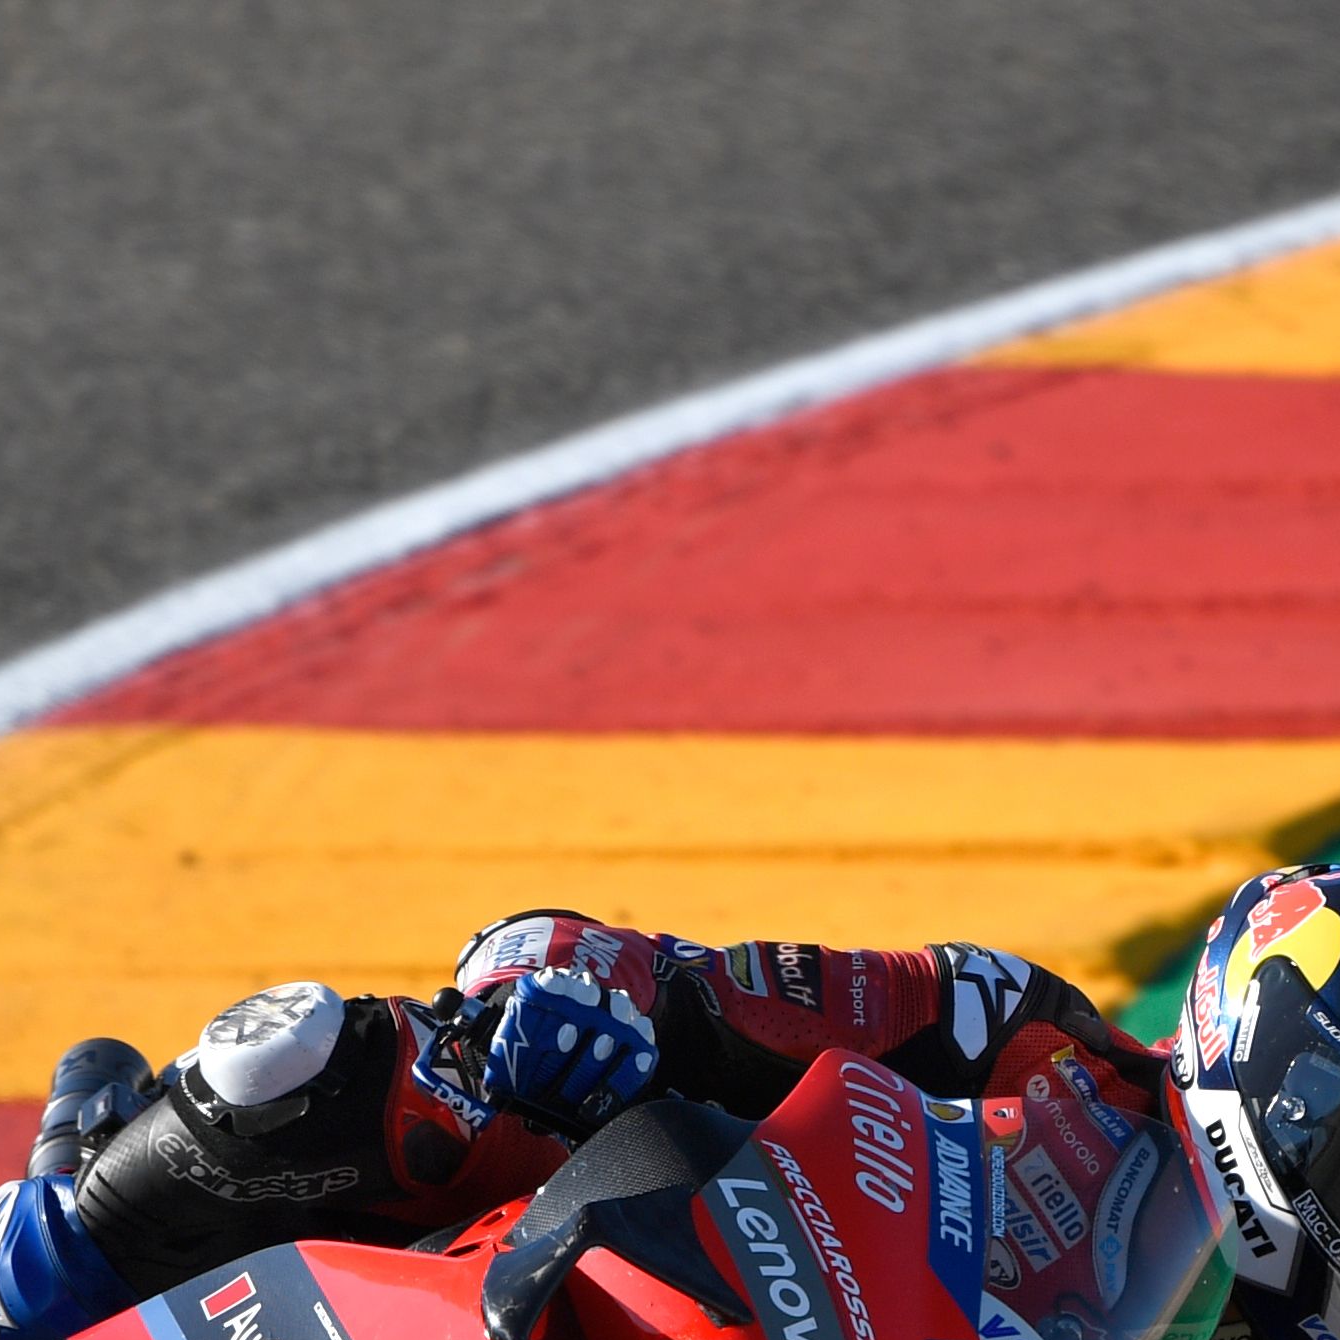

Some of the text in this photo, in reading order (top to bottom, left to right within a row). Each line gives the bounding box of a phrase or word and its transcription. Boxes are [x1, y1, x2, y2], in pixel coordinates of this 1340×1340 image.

[852, 975, 867, 1026] Sport
[843, 1066, 911, 1214] riello
[1045, 1101, 1101, 1176] motorola
[1074, 1077, 1127, 1139] MICHELIN
[156, 1133, 359, 1202] alpinestars
[934, 1130, 972, 1254] ADVANCE
[1106, 1147, 1151, 1234] BANCOMAT
[1205, 1119, 1278, 1259] DUCATI
[1003, 1195, 1052, 1262] alsir
[1030, 1173, 1085, 1243] riello
